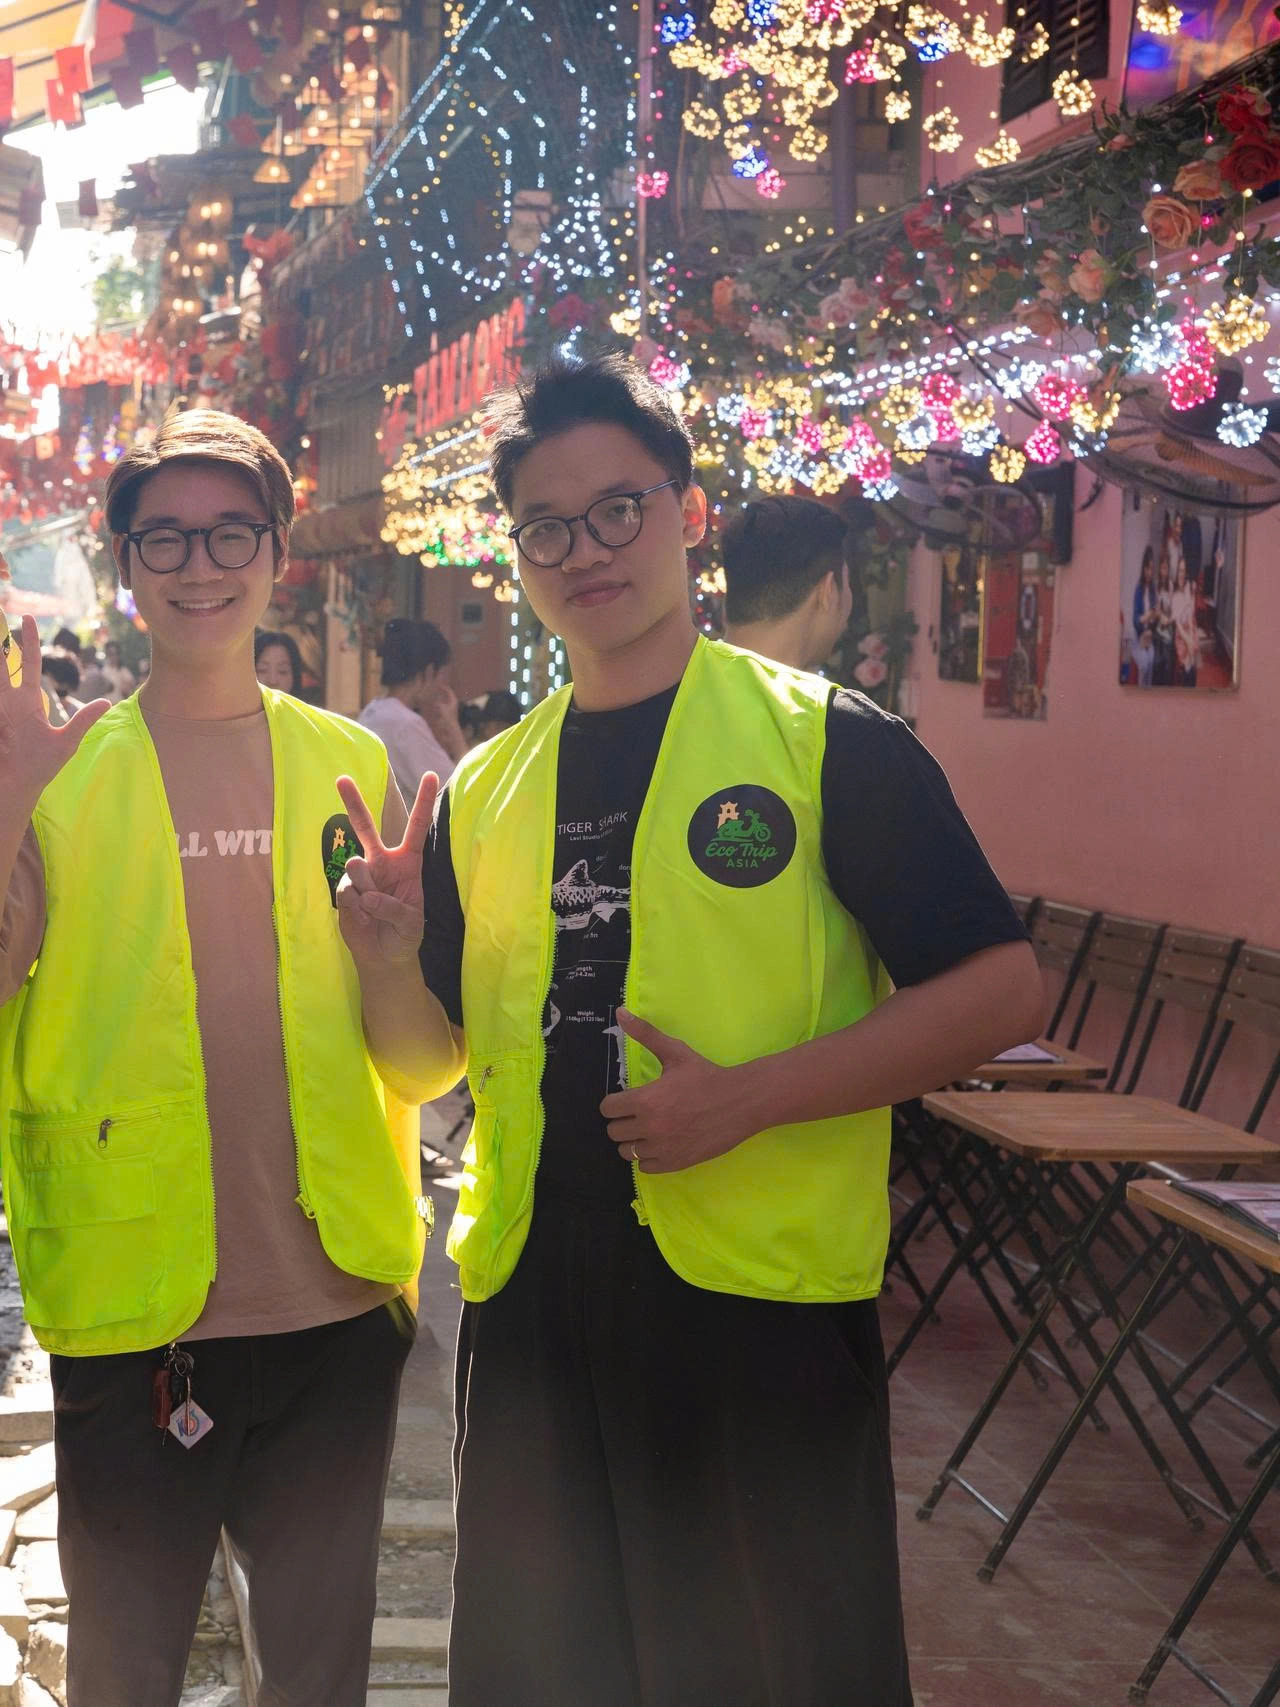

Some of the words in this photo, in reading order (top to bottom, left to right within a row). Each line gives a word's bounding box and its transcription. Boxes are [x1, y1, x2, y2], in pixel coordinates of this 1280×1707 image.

[557, 821, 593, 836] TIGER
[705, 842, 739, 857] Eco
[739, 843, 779, 862] Trip
[726, 859, 759, 869] ASIA
